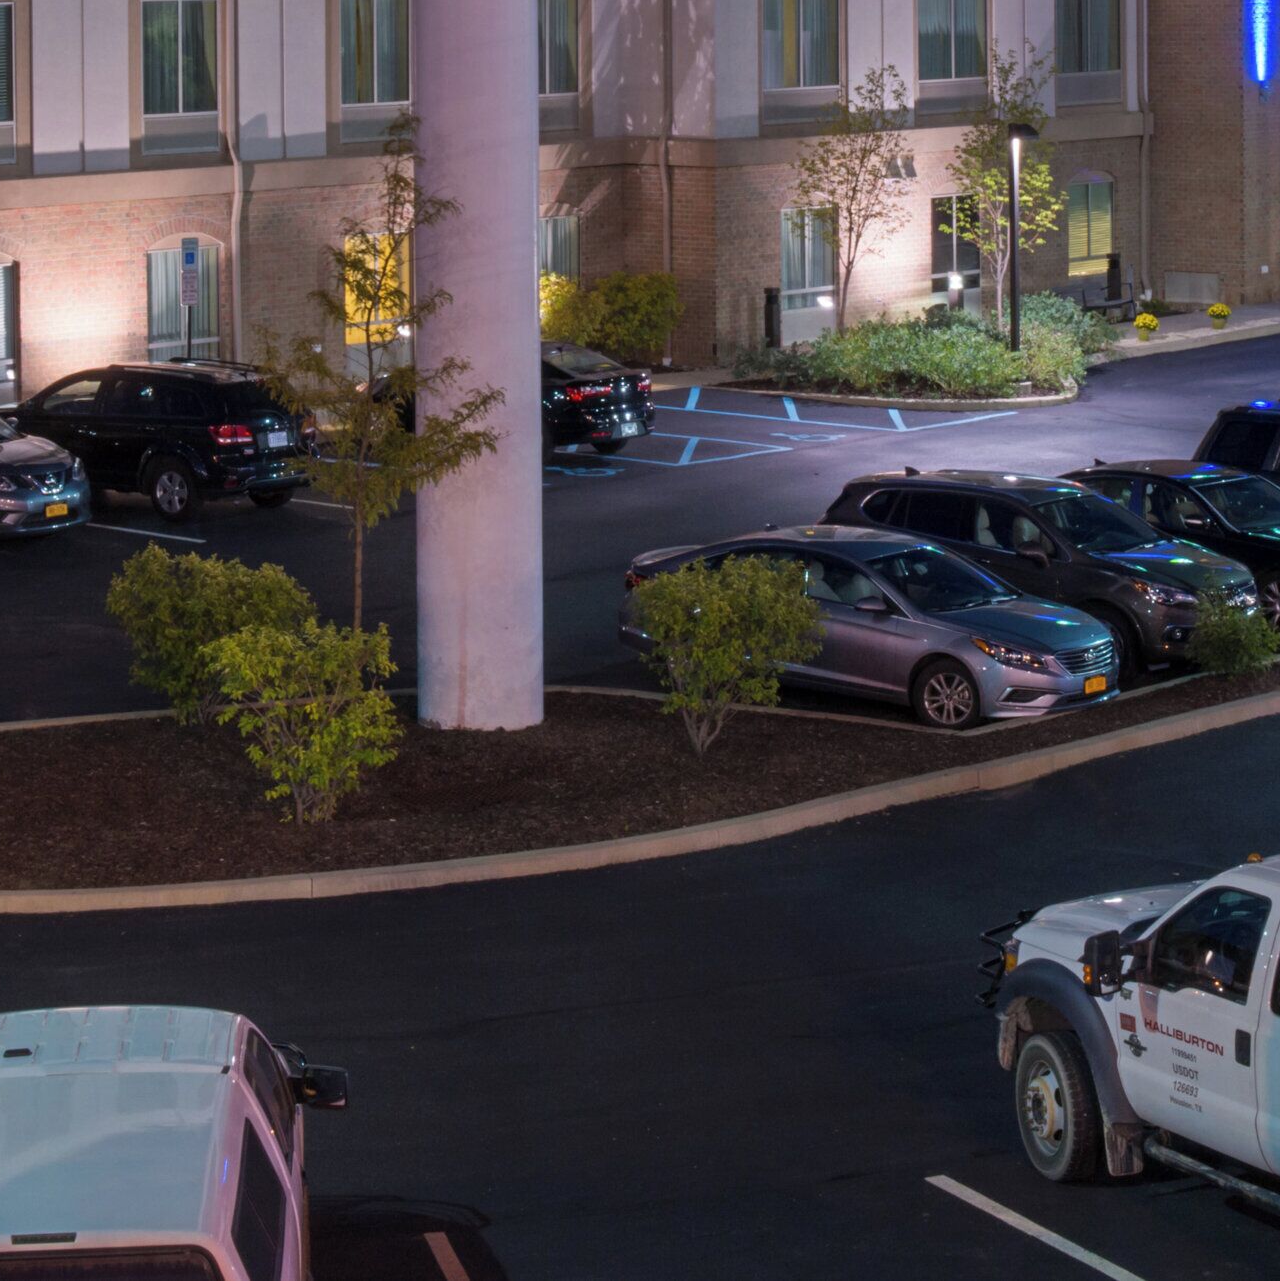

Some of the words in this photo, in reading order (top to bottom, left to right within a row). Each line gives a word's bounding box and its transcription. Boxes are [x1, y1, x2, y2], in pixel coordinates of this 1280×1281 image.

[1144, 1018, 1224, 1056] HALLIBURTON
[1172, 1063, 1198, 1080] USDOT
[1173, 1080, 1199, 1098] 126693
